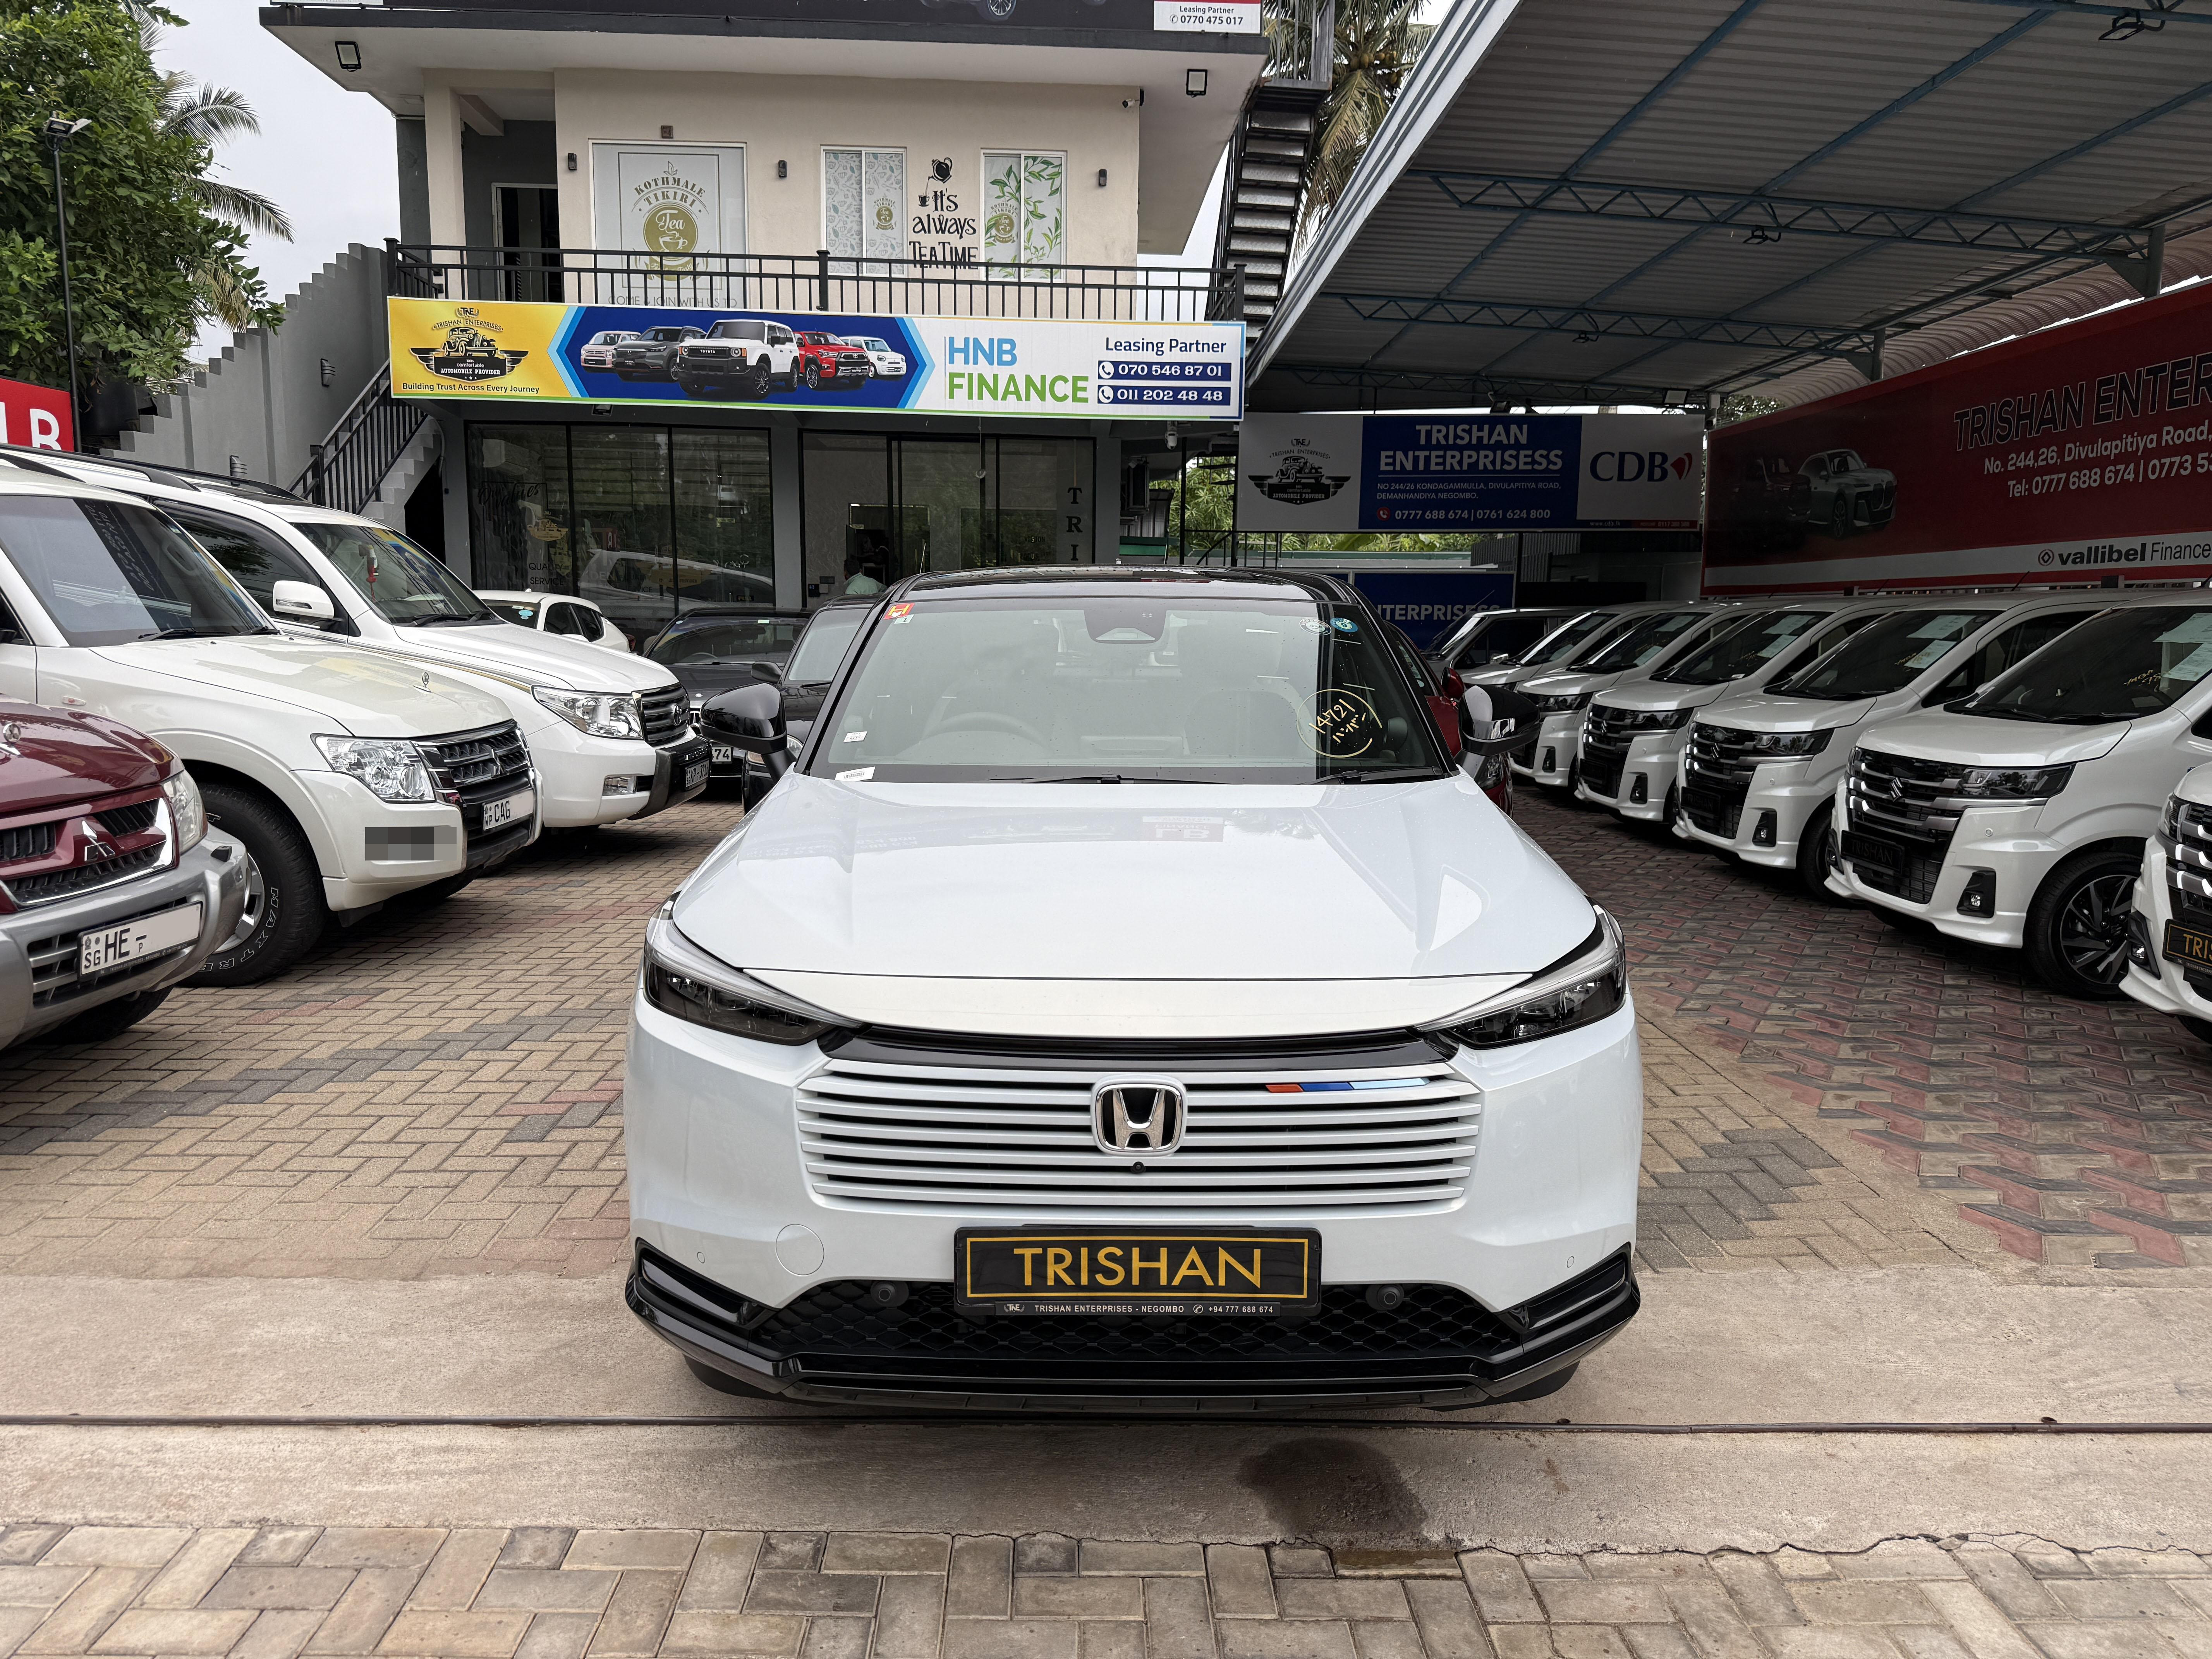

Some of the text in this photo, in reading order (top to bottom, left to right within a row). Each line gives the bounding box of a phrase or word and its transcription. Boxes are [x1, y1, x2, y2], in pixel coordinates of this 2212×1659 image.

[1180, 5, 1206, 14] Leasing
[1180, 15, 1243, 25] 0770 475 017
[634, 177, 706, 197] KOTHMALE
[643, 191, 697, 208] TIKIRI
[932, 188, 958, 213] It's
[656, 210, 685, 230] Tea
[912, 214, 977, 240] always
[436, 318, 502, 331] TRISHAN ENTERPRISES
[948, 336, 1018, 366] HNB
[1105, 337, 1227, 357] Leasing Partner
[1118, 365, 1222, 377] 070 546 87 01
[402, 383, 434, 392] Building
[486, 385, 508, 393] Every
[510, 385, 539, 394] Journey
[948, 372, 1089, 403] FINANCE
[1117, 389, 1223, 402] 011 202 48 48
[1953, 351, 2212, 452] TRISHAN ENTER
[1415, 424, 1528, 445] TRISHAN
[1272, 449, 1329, 459] TRISHAN ENTERPRISES
[1984, 419, 2212, 475] No. 244,26, Divulapitiya Road,
[1379, 449, 1563, 471] ENTERPRISESS
[1589, 451, 1669, 482] CDB
[2008, 480, 2029, 498] Tel:
[2032, 472, 2067, 495] 0777
[2069, 469, 2100, 490] 688
[2104, 464, 2135, 485] 674
[2147, 454, 2191, 480] 0773
[1416, 483, 1486, 491] KONDAGAMMULLA,
[1538, 482, 1561, 490] ROAD,
[1395, 510, 1422, 520] 0777
[1424, 510, 1445, 519] 688
[1448, 510, 1469, 519] 674
[1476, 510, 1503, 519] 0761
[1506, 510, 1527, 519] 624
[1530, 510, 1551, 519] 800
[2057, 541, 2212, 566] vallibel Finance
[712, 749, 730, 760] 74
[84, 949, 101, 969] SG
[1013, 1245, 1261, 1288] TRISHAN
[1034, 1305, 1072, 1313] TRISHAN
[1074, 1305, 1133, 1313] ENTERPRISES
[1141, 1305, 1185, 1313] NEGOMBO
[1208, 1305, 1223, 1313] +94
[1225, 1305, 1239, 1313] 777
[1242, 1305, 1256, 1313] 688
[1259, 1305, 1274, 1313] 674
